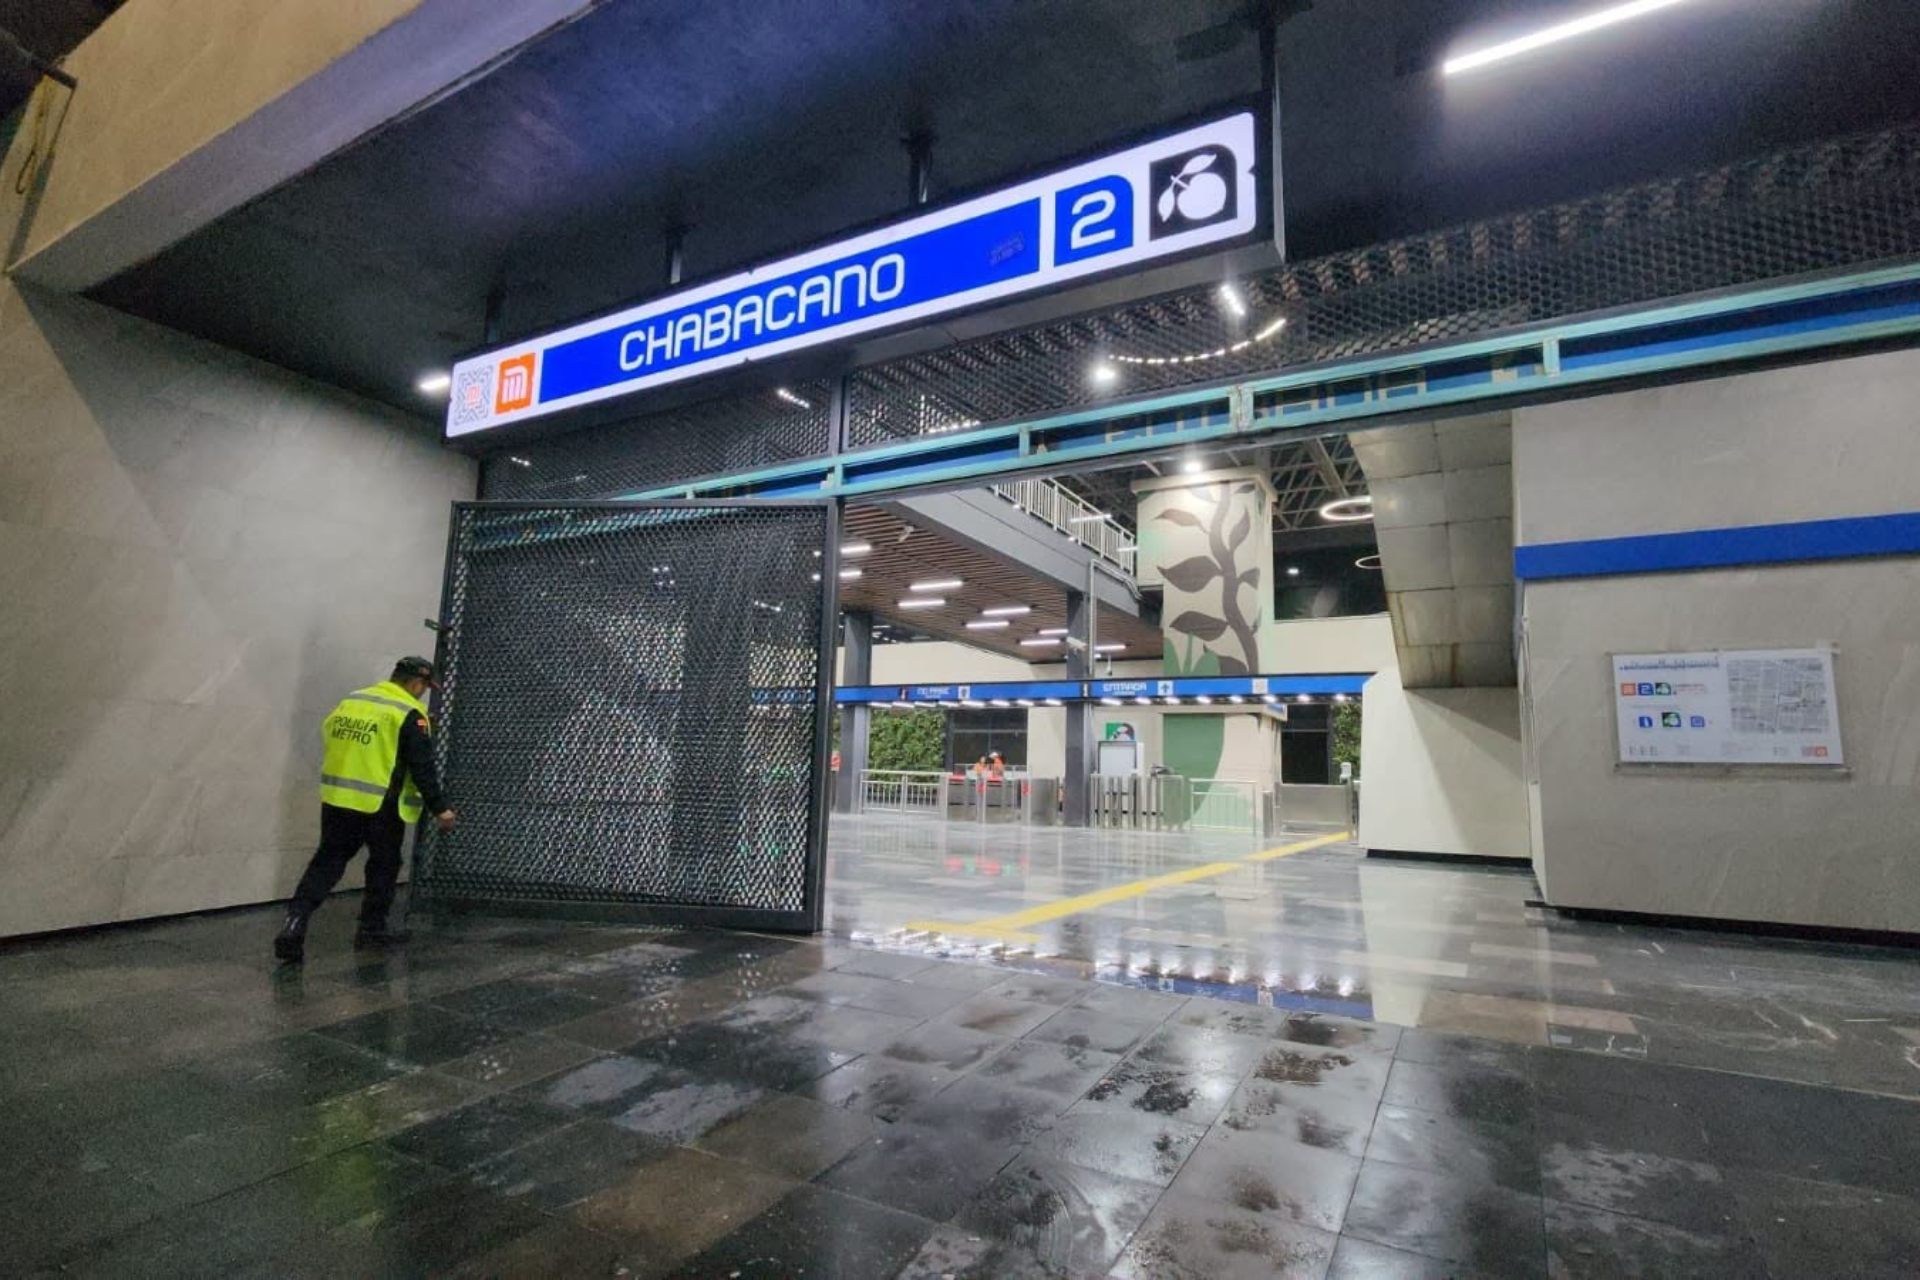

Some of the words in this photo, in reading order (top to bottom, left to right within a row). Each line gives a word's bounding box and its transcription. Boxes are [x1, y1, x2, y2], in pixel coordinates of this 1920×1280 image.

[1070, 190, 1116, 250] 2
[619, 253, 905, 371] CHABACANO
[332, 727, 371, 744] METRO
[334, 715, 378, 734] POLICÍA
